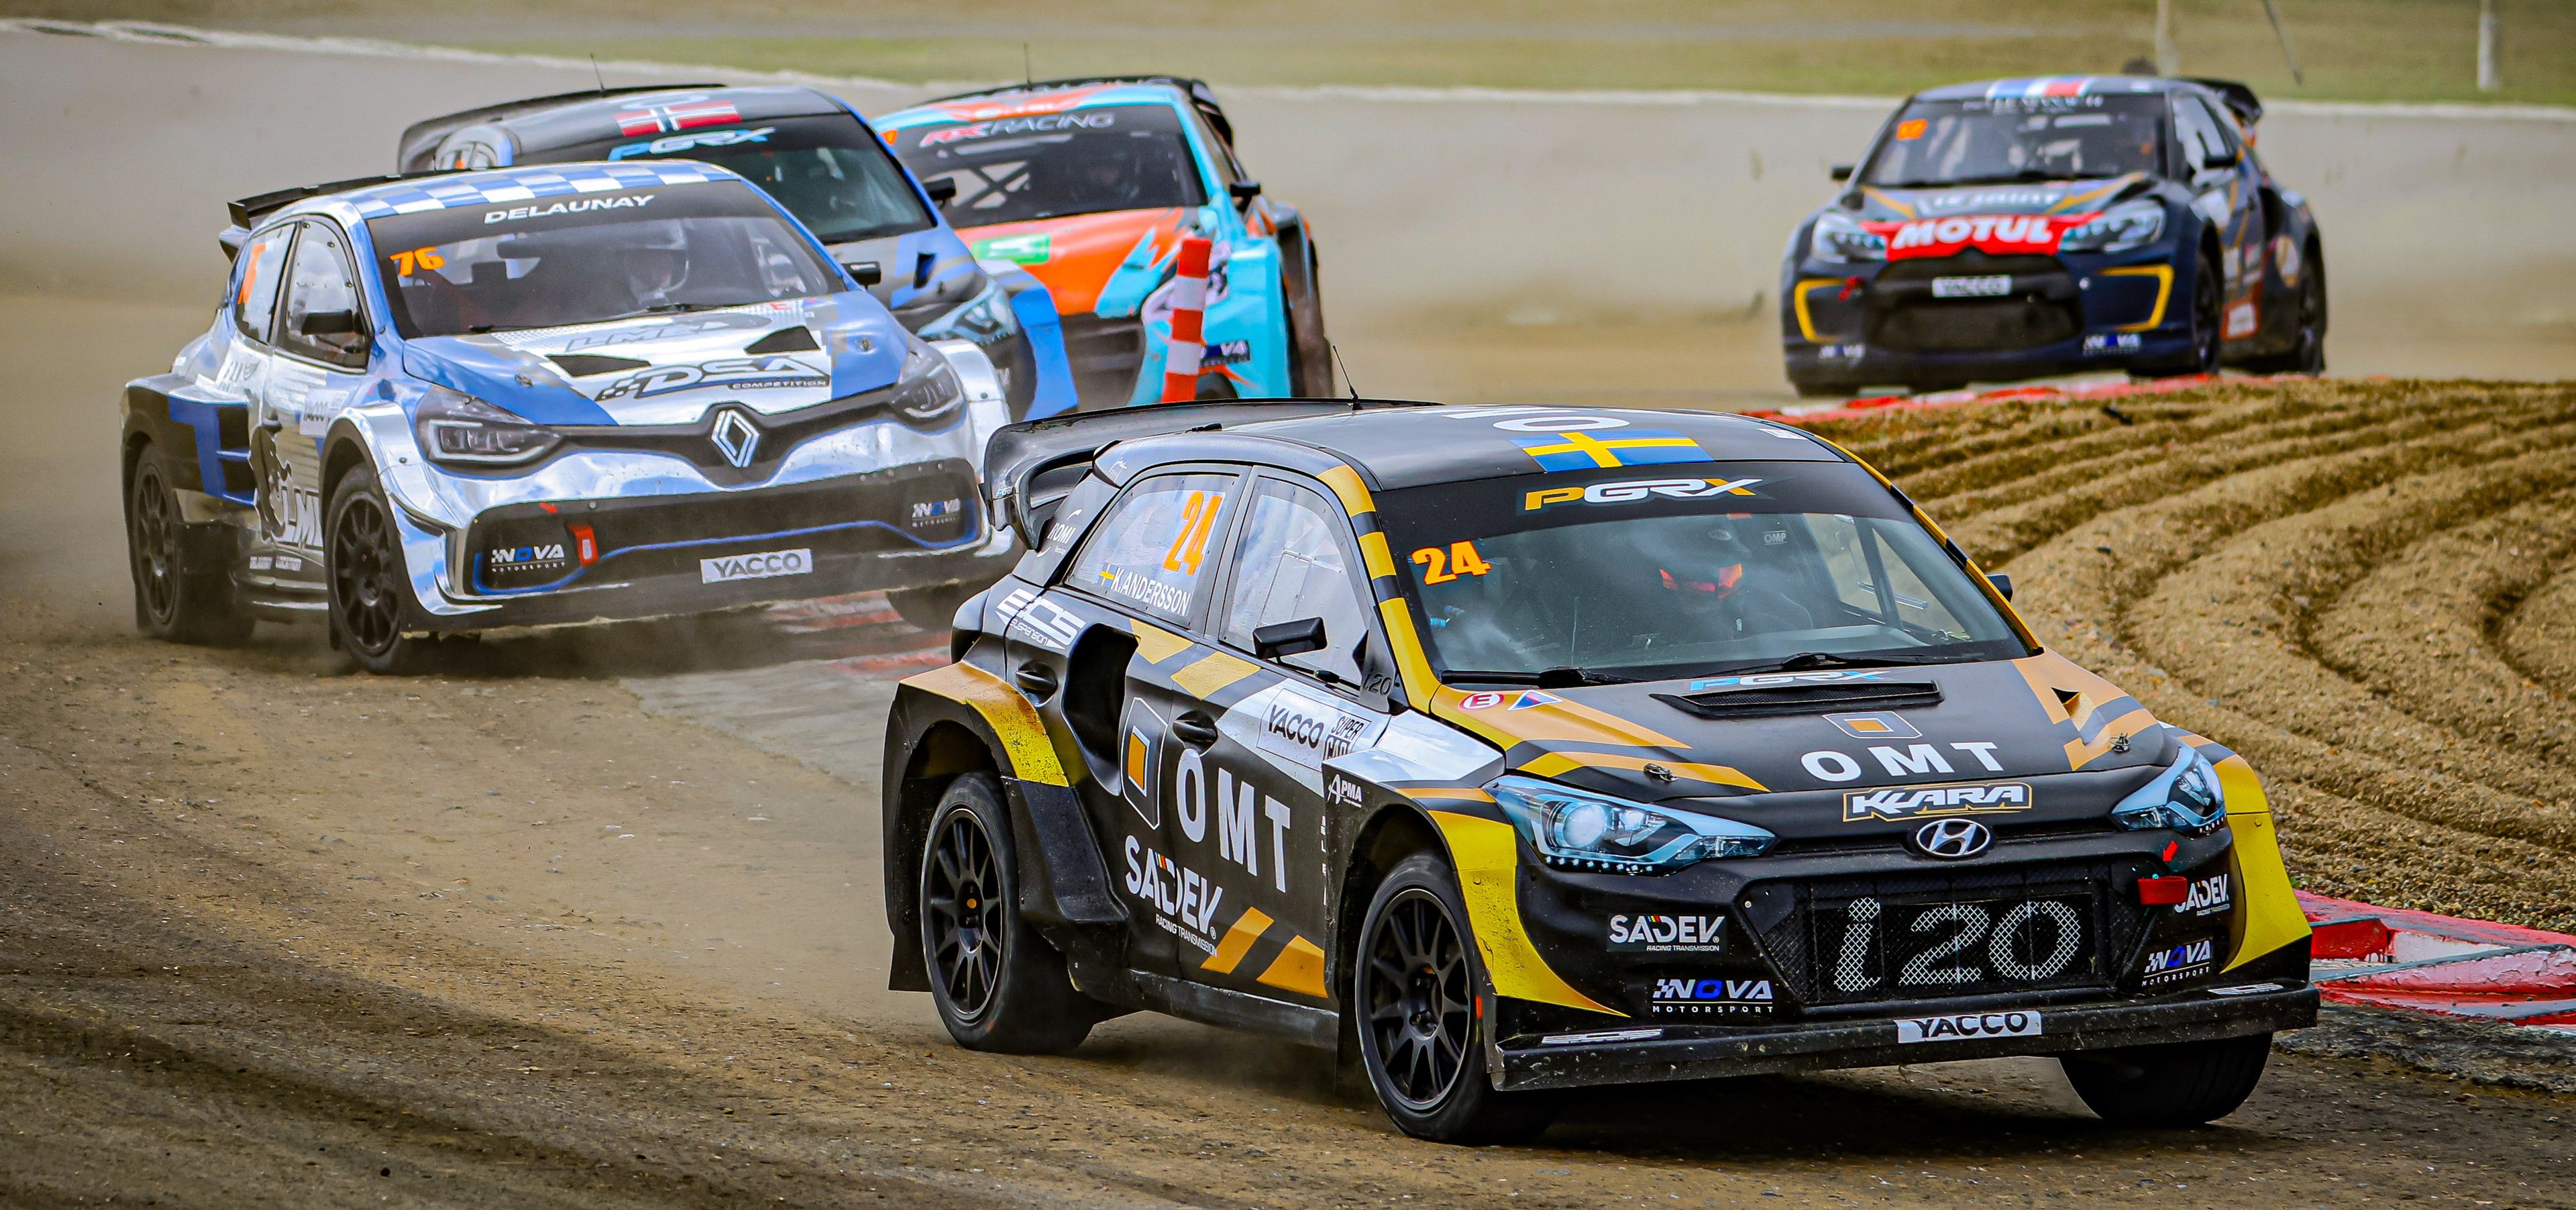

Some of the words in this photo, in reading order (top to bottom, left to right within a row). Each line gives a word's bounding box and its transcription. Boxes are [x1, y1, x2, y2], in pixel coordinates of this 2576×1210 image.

[484, 195, 655, 225] DELAUNAY
[1892, 215, 2053, 249] MOTUL
[390, 246, 445, 277] 76
[637, 356, 830, 397] DSA
[1525, 478, 1763, 511] PGRX
[1163, 490, 1223, 575] 24
[1764, 532, 1786, 544] OMP
[491, 544, 565, 563] NOVA
[713, 553, 801, 578] YACCO
[1411, 541, 1491, 586] 24
[1110, 567, 1191, 616] K.ANDERSSON
[1689, 671, 1892, 691] PGRX
[1269, 705, 1324, 749] YACCO
[1331, 716, 1364, 741] SUPER
[1801, 742, 2004, 782] OMT
[1177, 749, 1291, 893] OMT
[1125, 835, 1223, 935] SADEV
[2174, 874, 2229, 913] ADEV
[1156, 914, 1177, 934] RACING
[1177, 925, 1218, 957] TRANSMISSION
[1609, 915, 1725, 943] SADEV
[2145, 940, 2211, 973] NOVA
[1652, 978, 1773, 999] NOVA
[2142, 966, 2210, 987] MOTORSPORT
[1652, 1005, 1773, 1013] MOTORSPORT
[1909, 1013, 2028, 1039] YACCO
